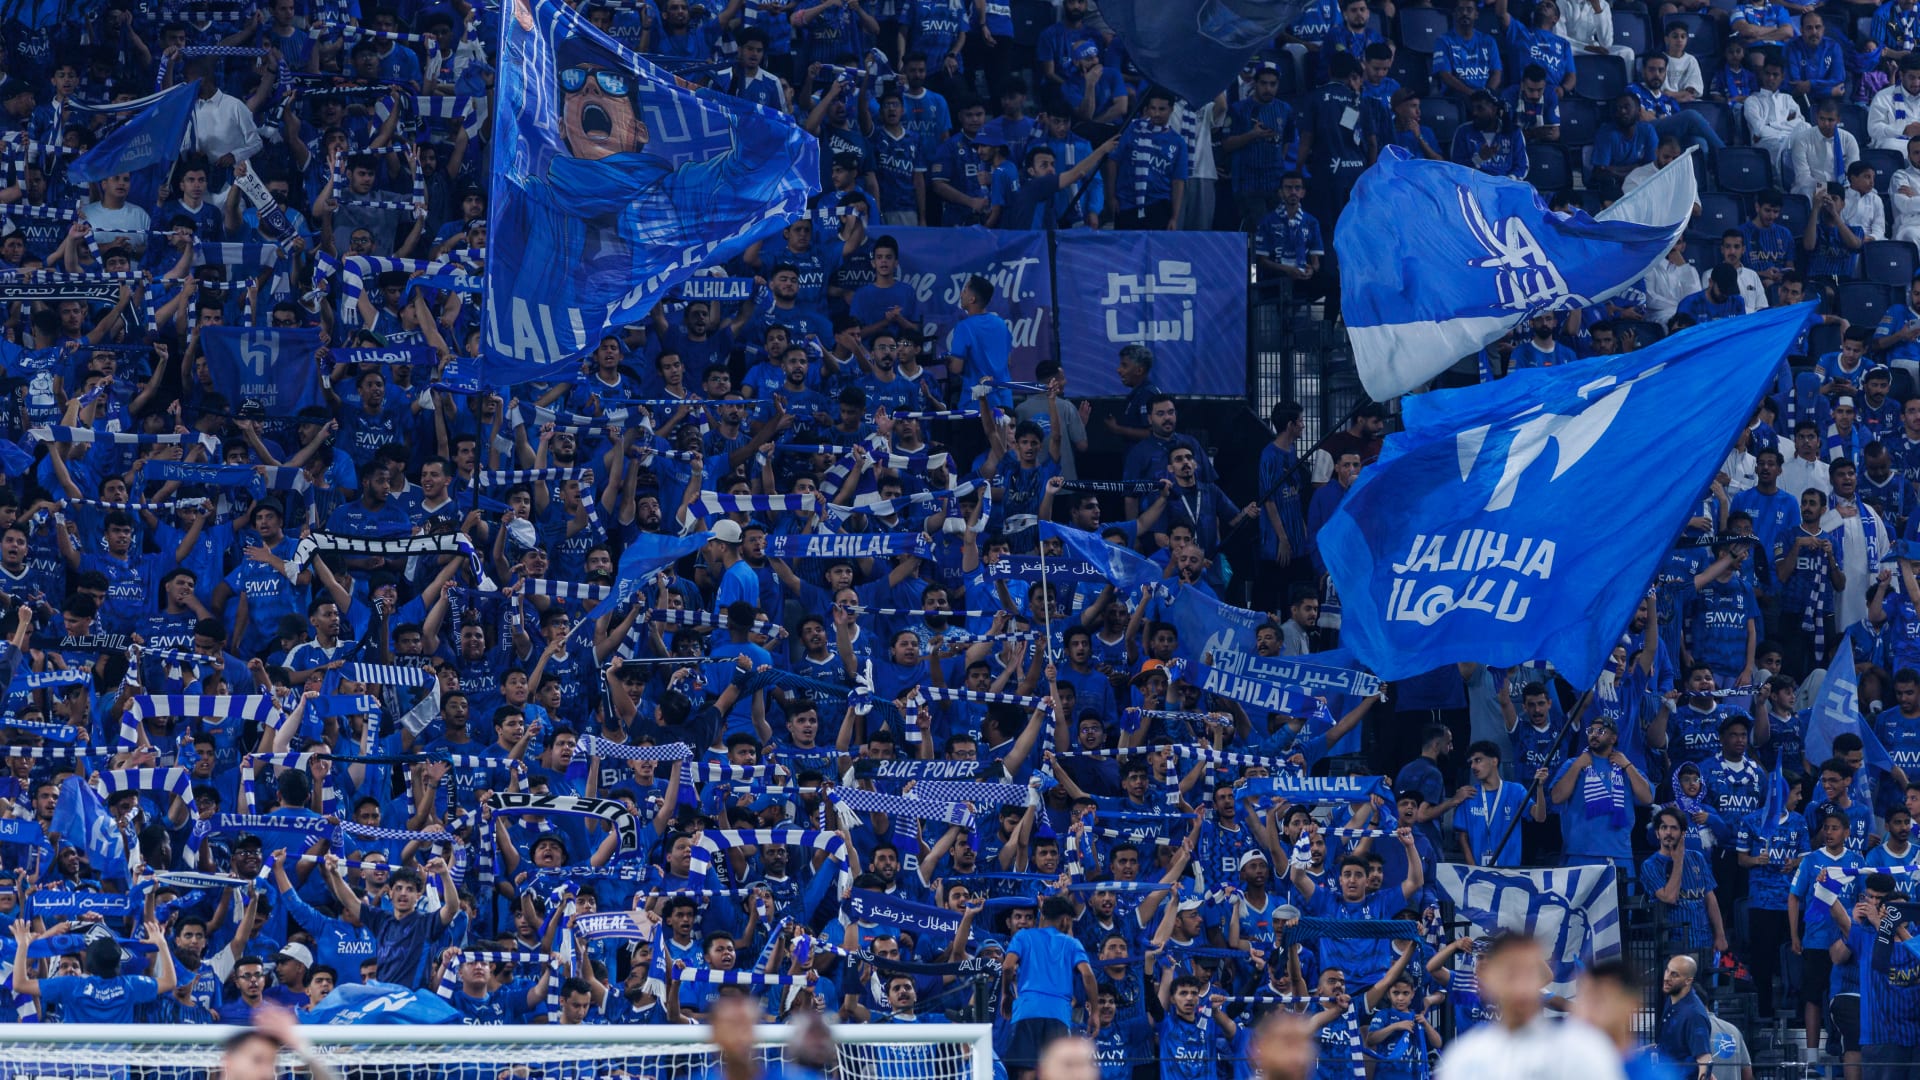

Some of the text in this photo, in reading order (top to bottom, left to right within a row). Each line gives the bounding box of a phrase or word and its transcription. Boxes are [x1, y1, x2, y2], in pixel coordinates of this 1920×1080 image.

[608, 27, 641, 36] SAVV
[922, 20, 958, 31] SAVVY
[1294, 24, 1330, 33] SAVVY
[682, 279, 750, 299] ALHILAL
[1101, 260, 1197, 305] كبير
[349, 349, 412, 365] الهلال
[239, 383, 279, 395] ALHILAL
[805, 535, 894, 558] ALHILAL
[246, 578, 280, 593] SAVVY
[1705, 612, 1745, 624] SAVVY
[150, 635, 196, 648] SAVVY
[1300, 667, 1350, 689] كبير
[1204, 672, 1293, 713] ALHILAL
[877, 760, 980, 778] BLUE POWER
[1273, 776, 1362, 792] ALHILAL
[221, 814, 290, 830] ALHILAL
[338, 941, 372, 951] SAVVY
